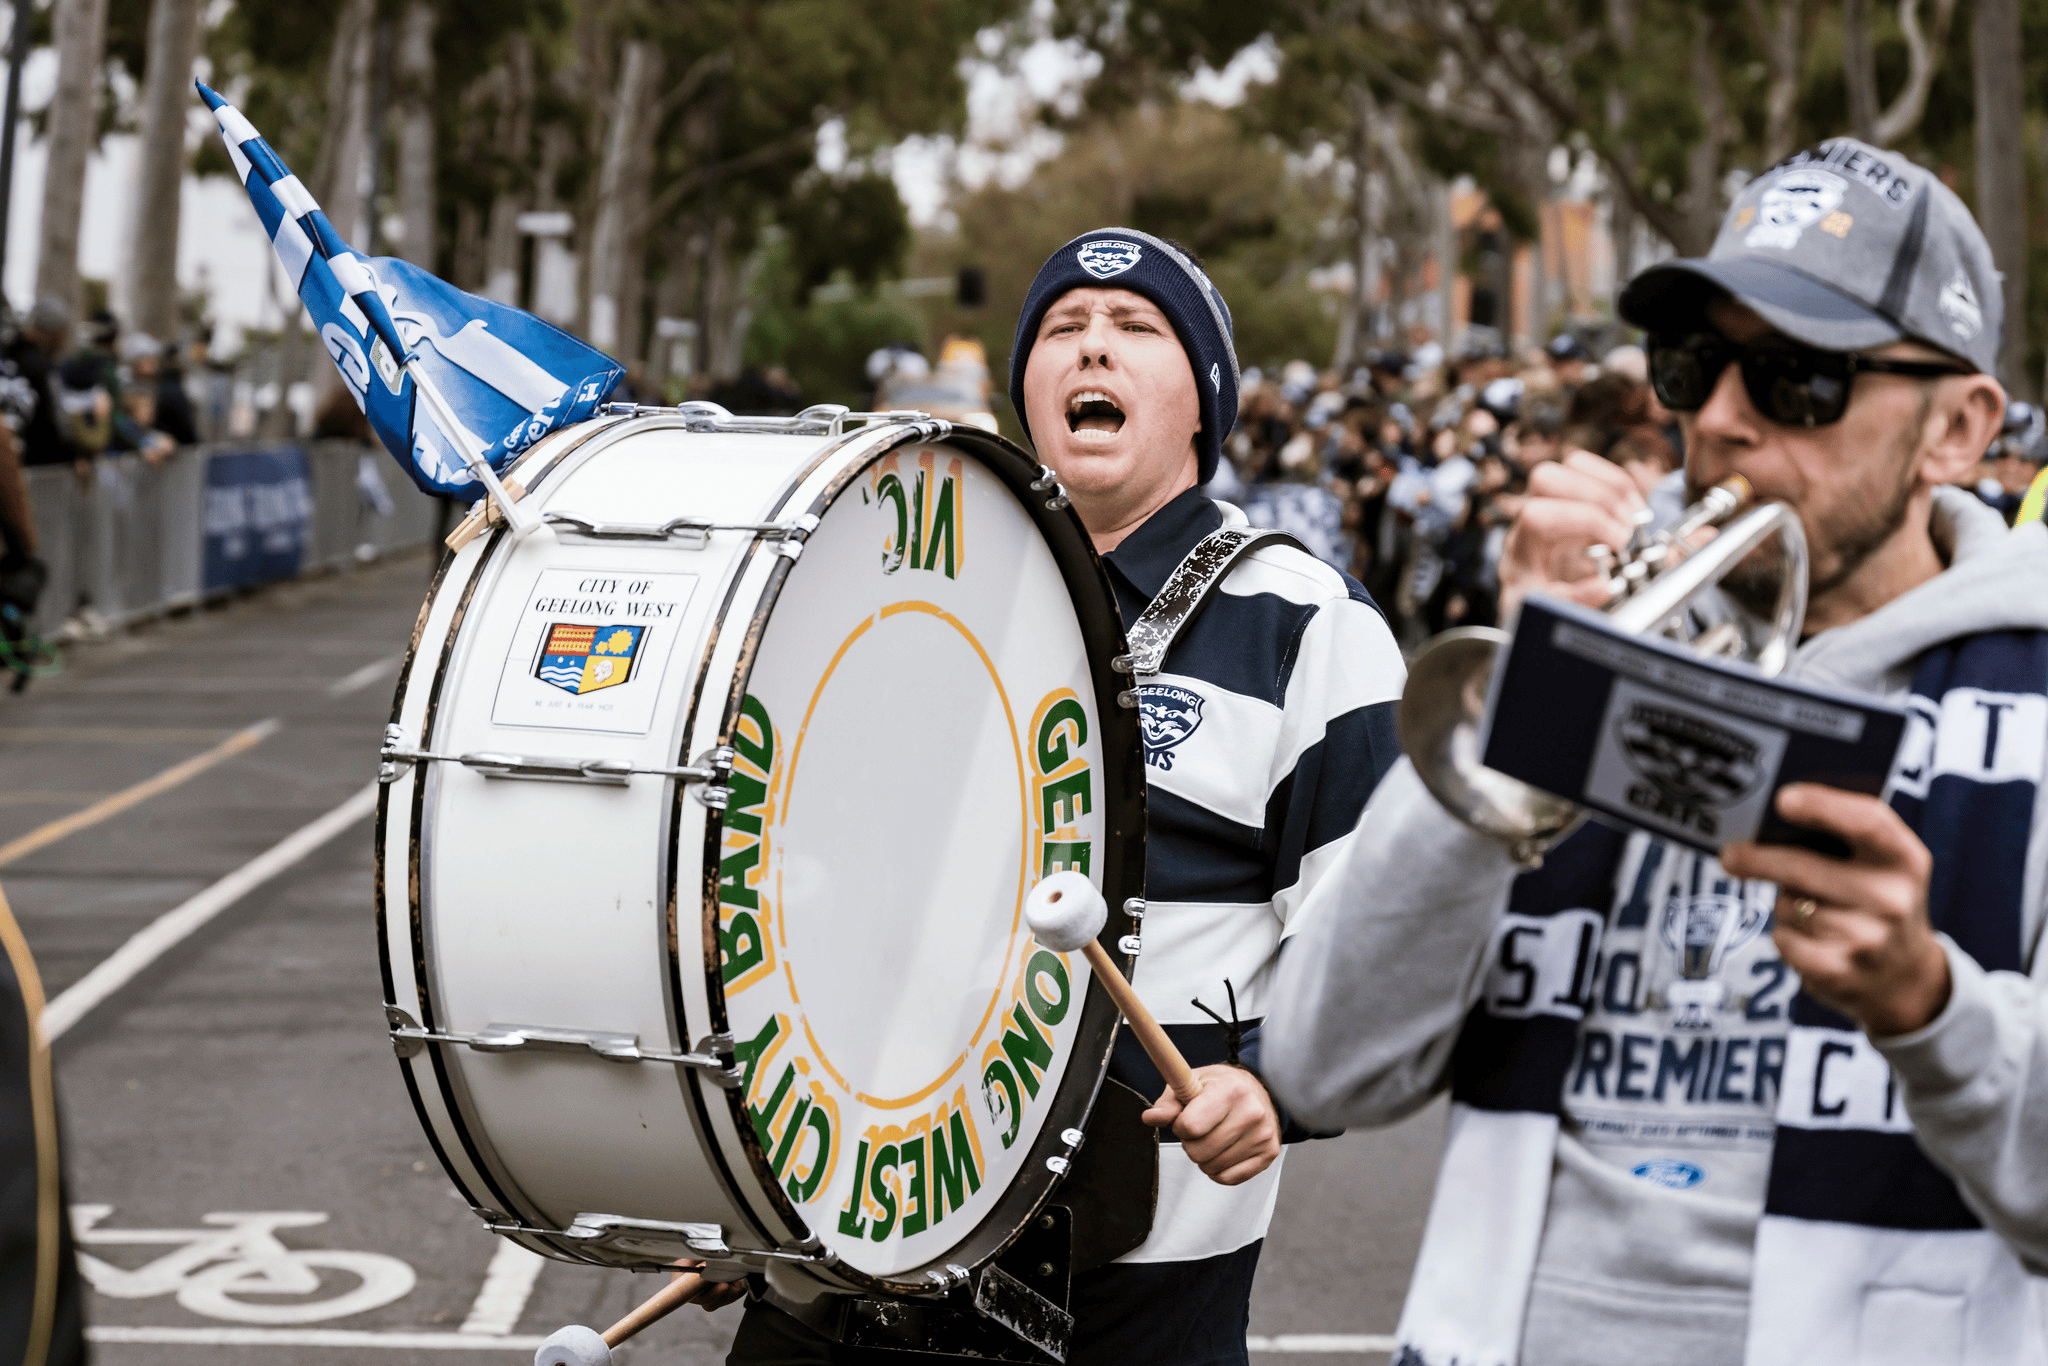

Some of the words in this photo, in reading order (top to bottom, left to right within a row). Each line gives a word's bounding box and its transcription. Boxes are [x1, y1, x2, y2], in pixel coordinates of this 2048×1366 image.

[1088, 242, 1134, 251] GEELONG
[535, 597, 617, 616] GEELONG
[627, 602, 678, 618] WEST
[579, 578, 621, 594] CITY
[628, 580, 653, 596] OF
[1139, 686, 1198, 706] GEELONG
[720, 695, 780, 990] BAND
[981, 688, 1092, 1150] GEEONG
[1572, 1032, 1788, 1102] REMIER
[734, 1013, 836, 1204] CITY
[838, 1093, 984, 1244] WEST
